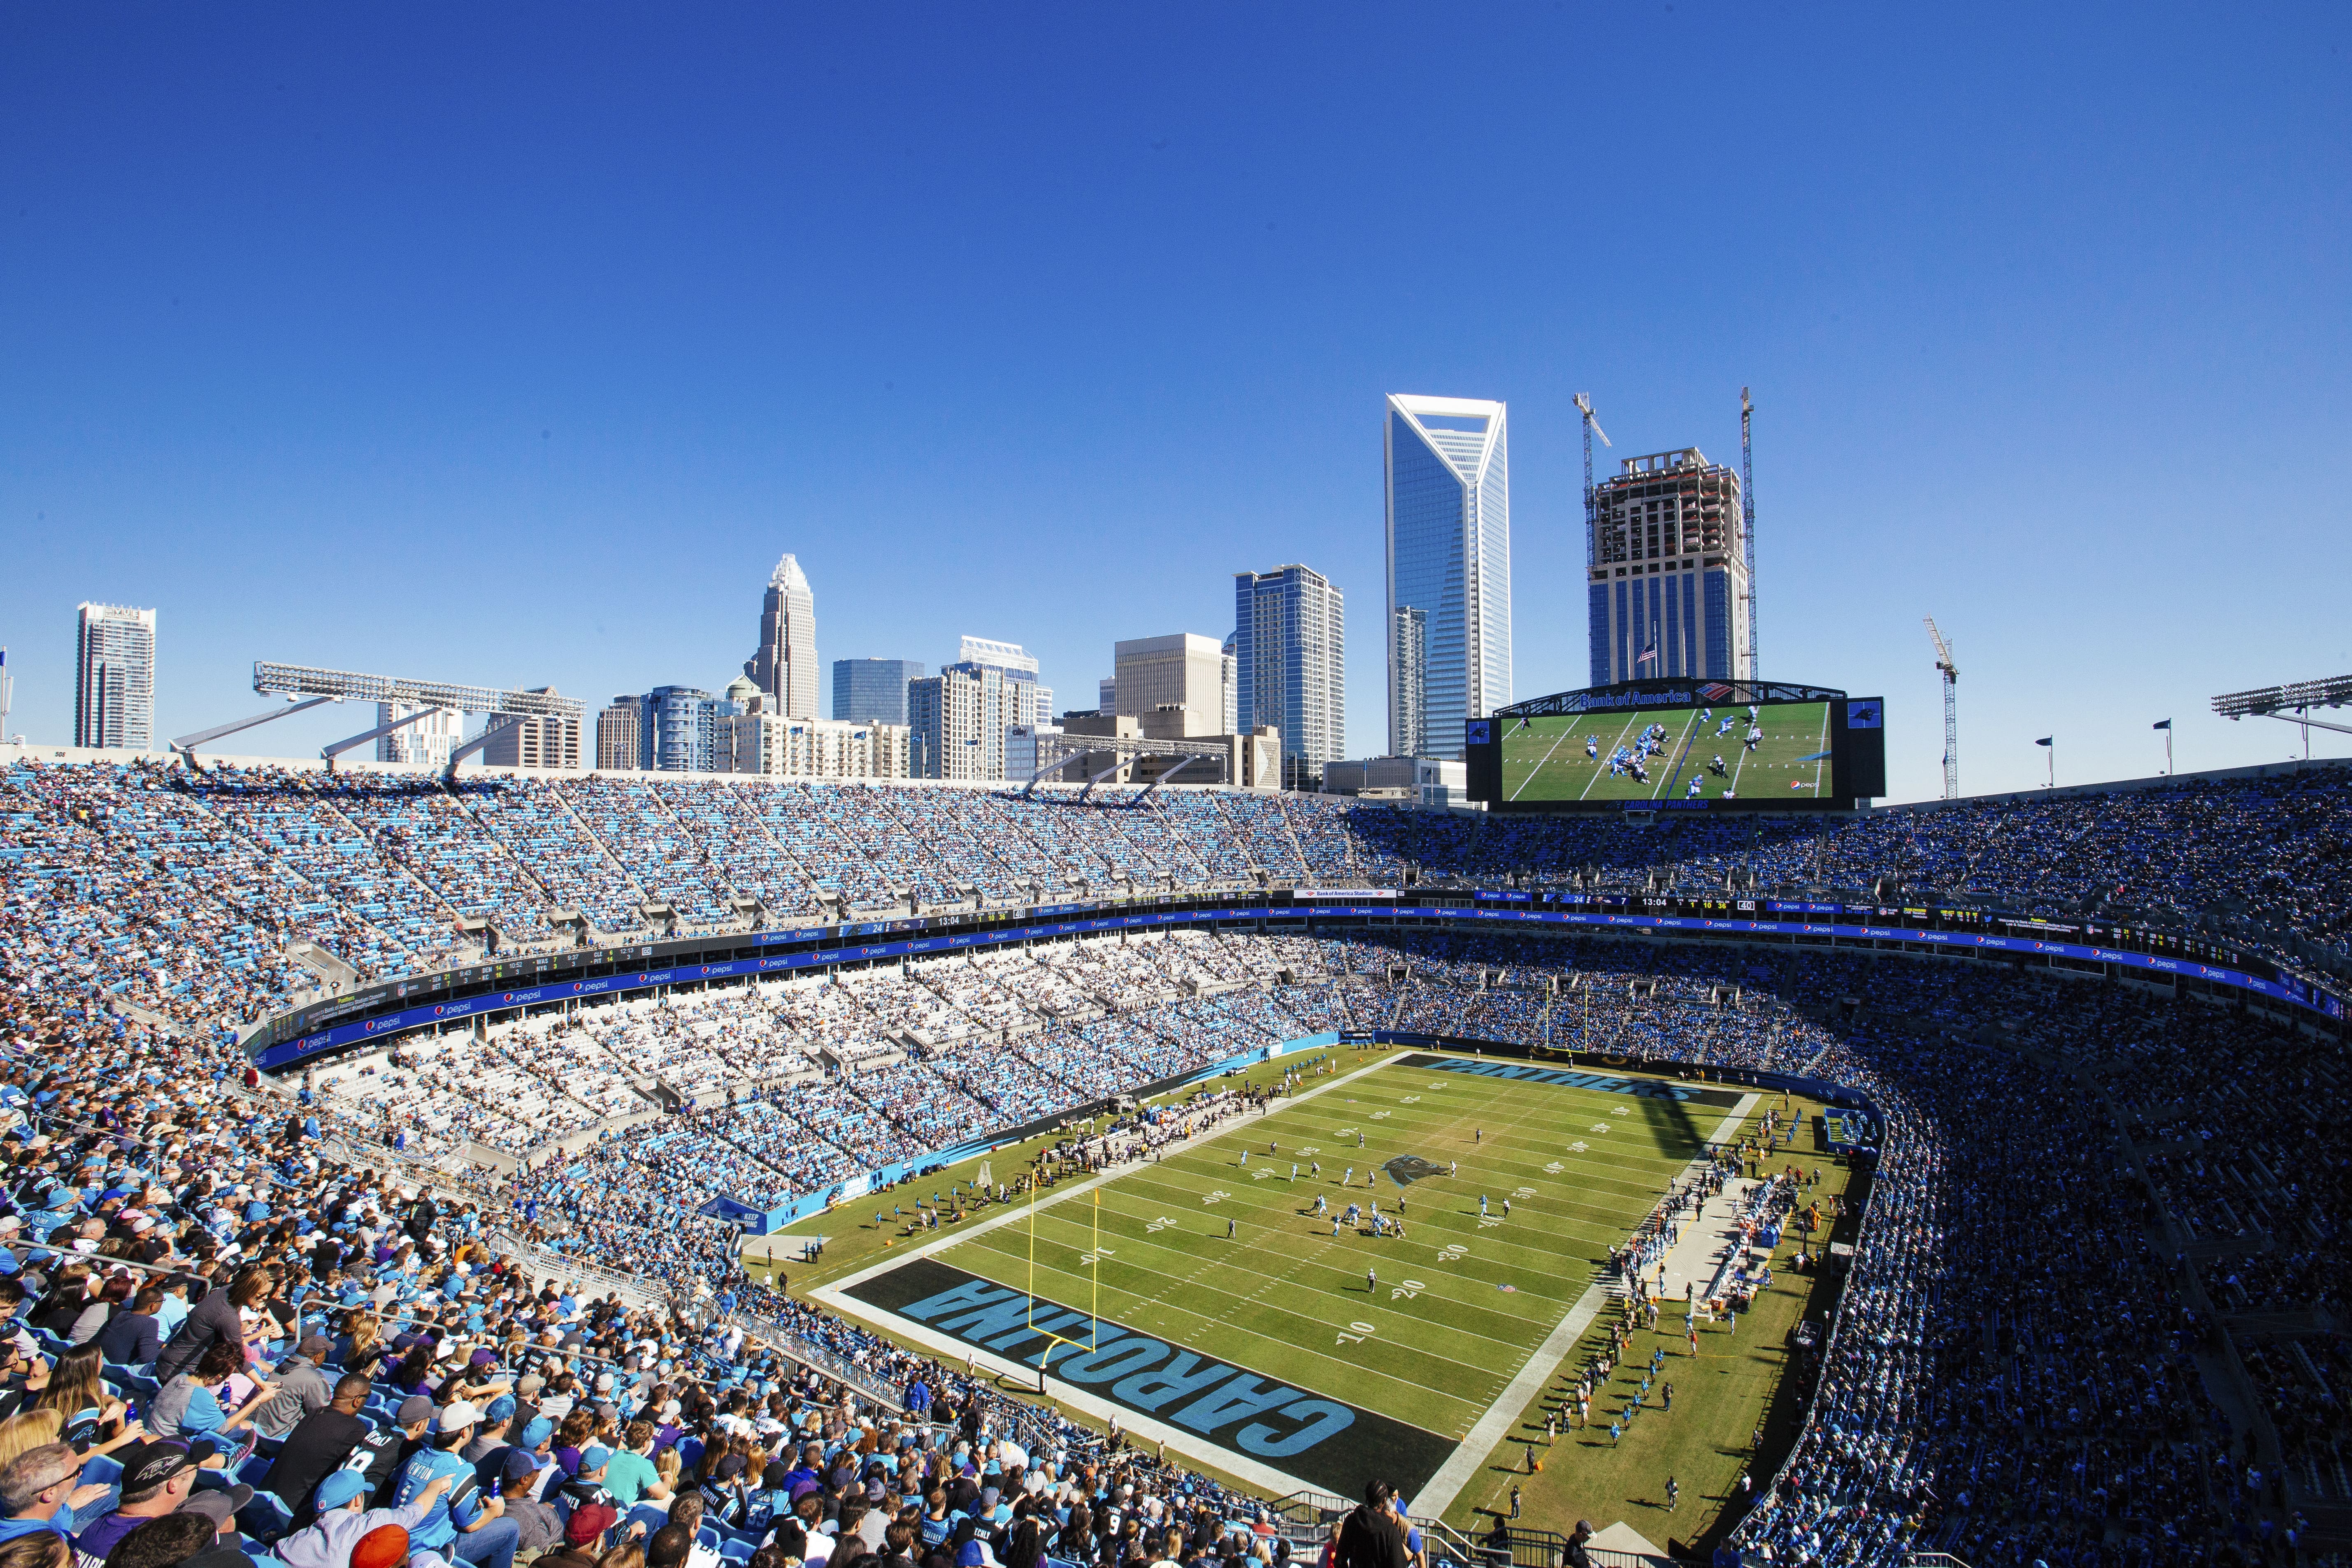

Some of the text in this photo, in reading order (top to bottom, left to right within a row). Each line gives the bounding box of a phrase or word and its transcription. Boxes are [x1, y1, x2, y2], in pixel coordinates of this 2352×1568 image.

[1580, 690, 1691, 708] Bank of America
[1624, 799, 1709, 809] CAROLINA PANTHERS
[919, 920, 925, 928] 7
[939, 916, 960, 926] 13:04
[873, 924, 883, 933] 24
[870, 947, 887, 955] pepsi
[2102, 952, 2123, 960] pepsi
[821, 952, 840, 961] pepsi
[769, 958, 788, 968] pepsi
[2157, 961, 2177, 969] pepsi
[711, 964, 732, 974] pepsi
[650, 972, 671, 983] pepsi
[2208, 970, 2226, 979] pepsi
[585, 980, 609, 992] pepsi
[516, 990, 541, 1003] pepsi
[446, 1002, 471, 1020] pepsi
[377, 1016, 401, 1031] pepsi
[308, 1033, 332, 1050] pepsi
[1423, 1058, 1702, 1101] PANTHERS
[1399, 1095, 1420, 1104] 20
[1369, 1111, 1391, 1120] 30
[1611, 1107, 1630, 1116] 10
[1334, 1127, 1358, 1137] 40
[1590, 1124, 1611, 1134] 20
[1295, 1147, 1320, 1157] 50
[1566, 1142, 1590, 1152] 30
[1251, 1168, 1276, 1178] 40
[1542, 1163, 1565, 1174] 40
[1202, 1190, 1231, 1204] 30
[1511, 1187, 1538, 1199] 50
[744, 1213, 759, 1221] KEEP
[1478, 1214, 1506, 1228] 40
[1145, 1216, 1177, 1231] 20
[1080, 1246, 1116, 1264] 10
[1438, 1244, 1469, 1261] 30
[1391, 1280, 1426, 1299] 20
[1336, 1322, 1375, 1344] 10
[898, 1280, 1355, 1457] CAROLINA
[406, 1460, 435, 1482] NEWTON
[592, 1487, 614, 1505] 70
